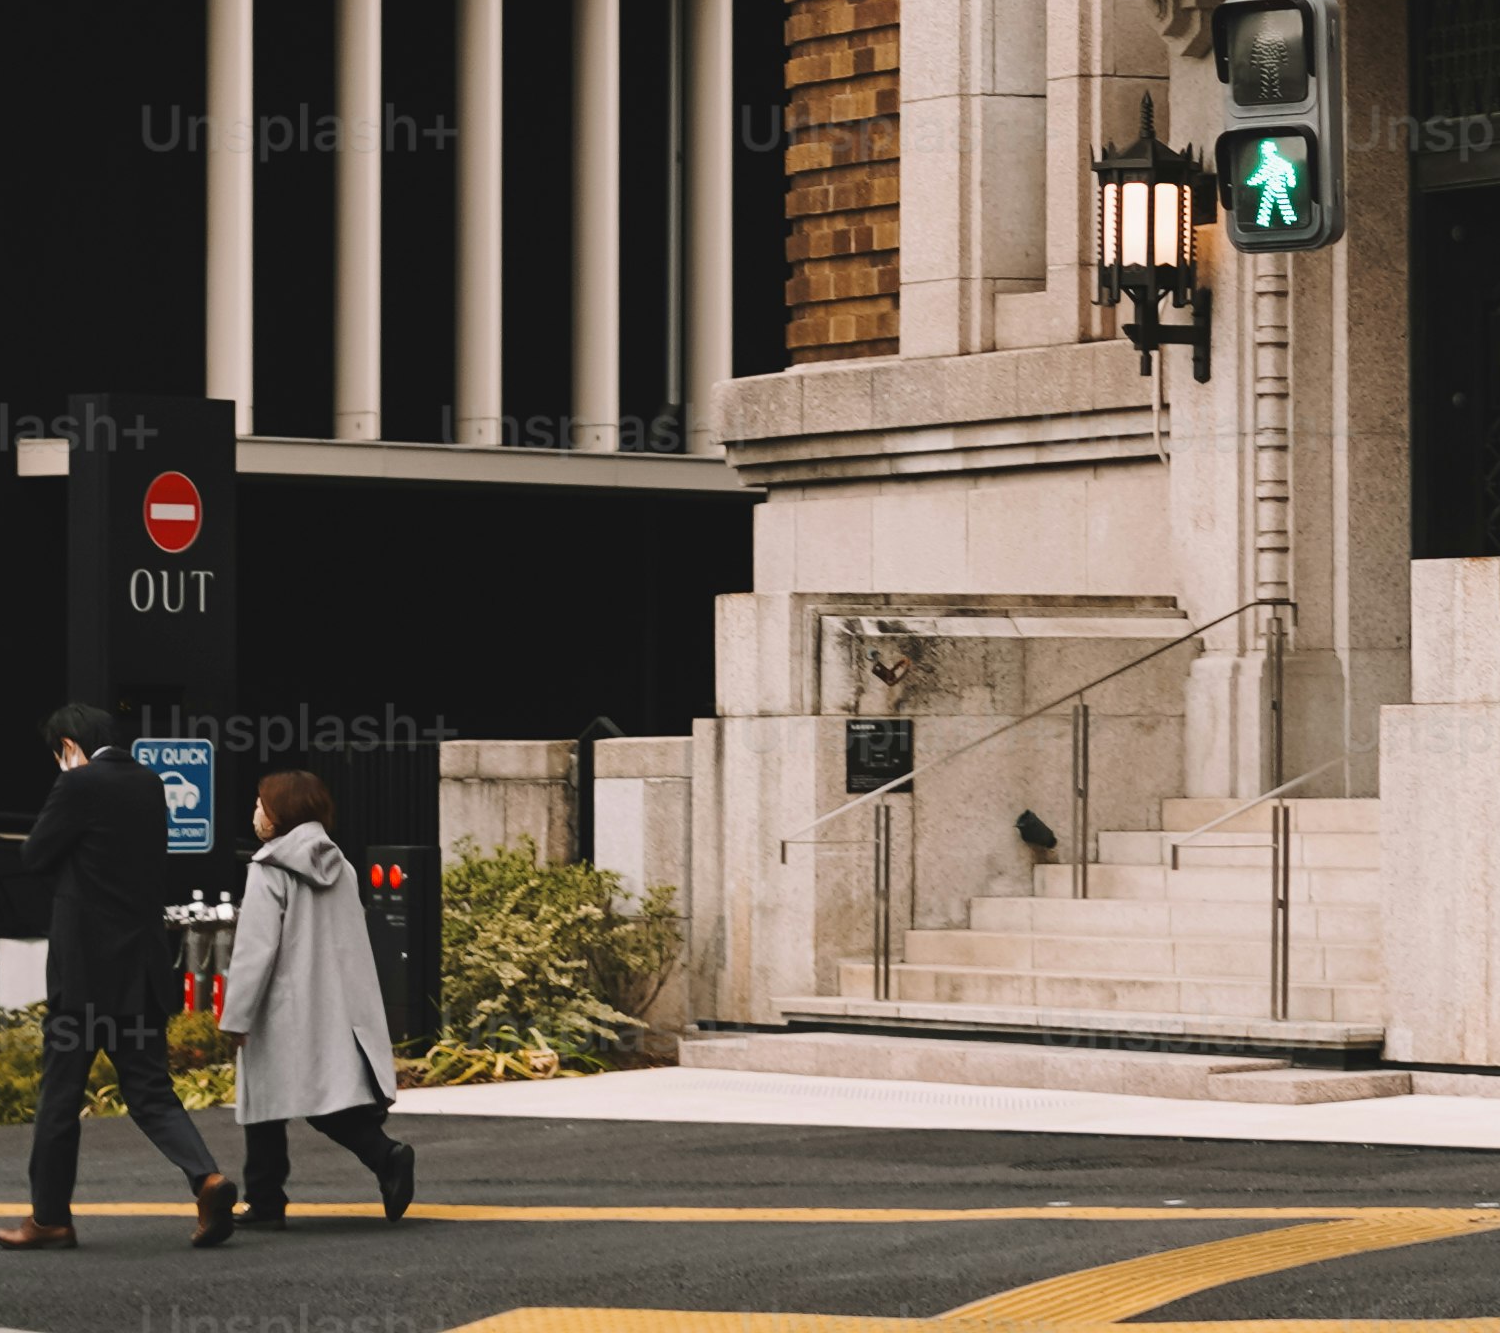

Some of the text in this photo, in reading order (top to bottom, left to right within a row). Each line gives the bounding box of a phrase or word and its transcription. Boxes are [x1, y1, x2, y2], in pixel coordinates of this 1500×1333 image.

[130, 568, 214, 613] OUT
[138, 747, 208, 766] EV QUICK
